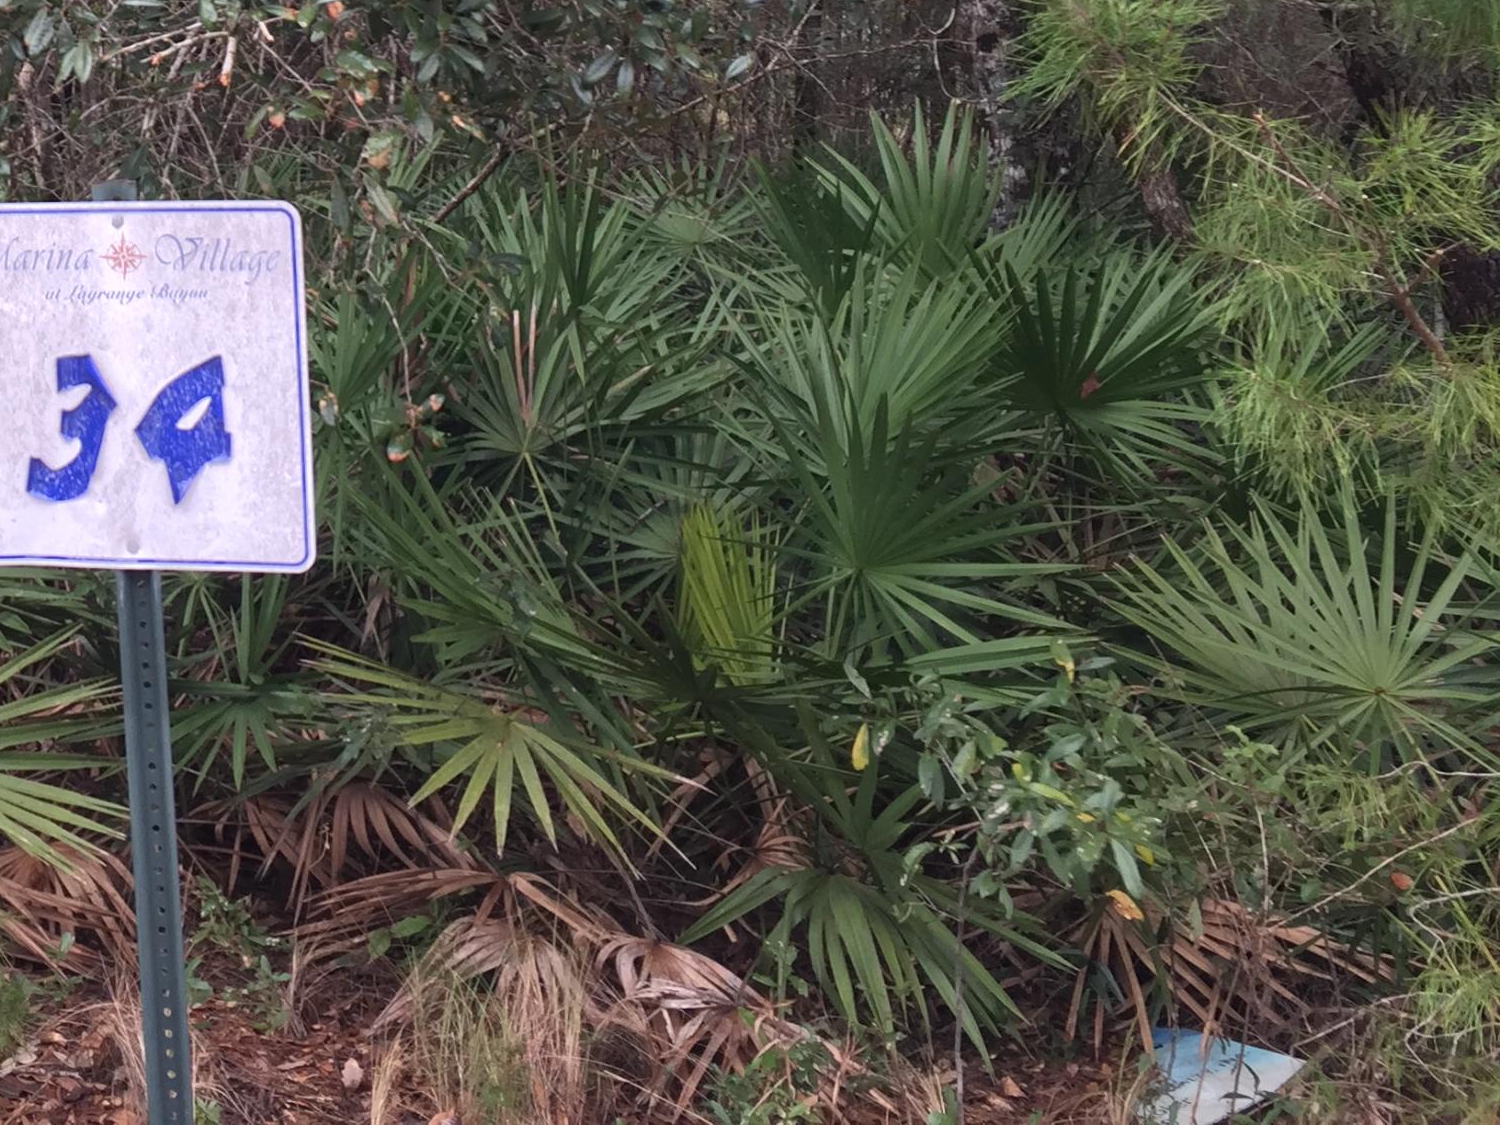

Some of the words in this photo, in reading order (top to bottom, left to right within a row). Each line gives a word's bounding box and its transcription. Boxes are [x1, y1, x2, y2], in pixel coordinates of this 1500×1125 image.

[154, 233, 282, 285] Village
[44, 288, 61, 300] at
[26, 353, 232, 506] 34
